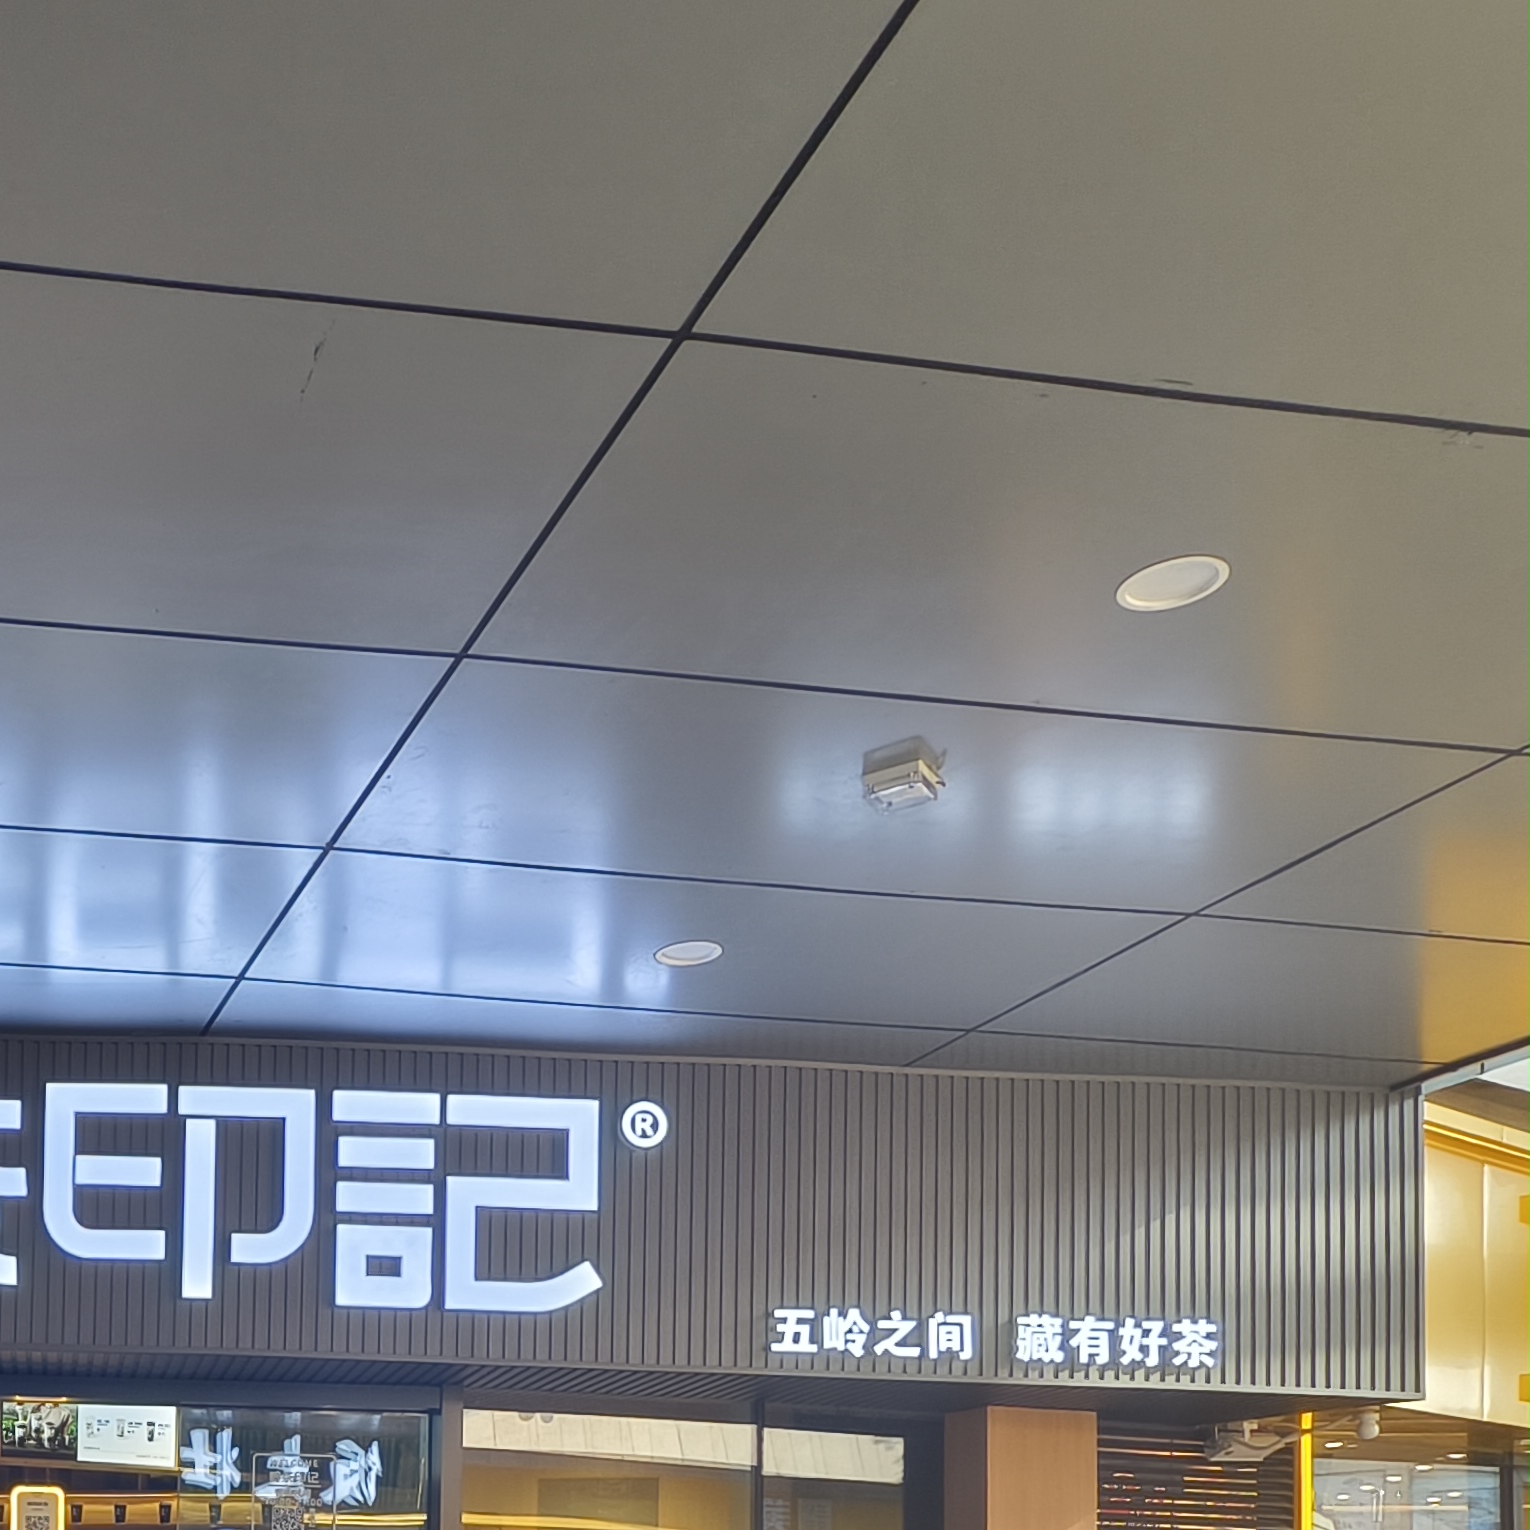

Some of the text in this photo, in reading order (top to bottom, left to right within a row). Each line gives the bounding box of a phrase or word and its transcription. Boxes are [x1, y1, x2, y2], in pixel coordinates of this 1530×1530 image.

[770, 1308, 1219, 1369] 五岭之间 藏有好茶
